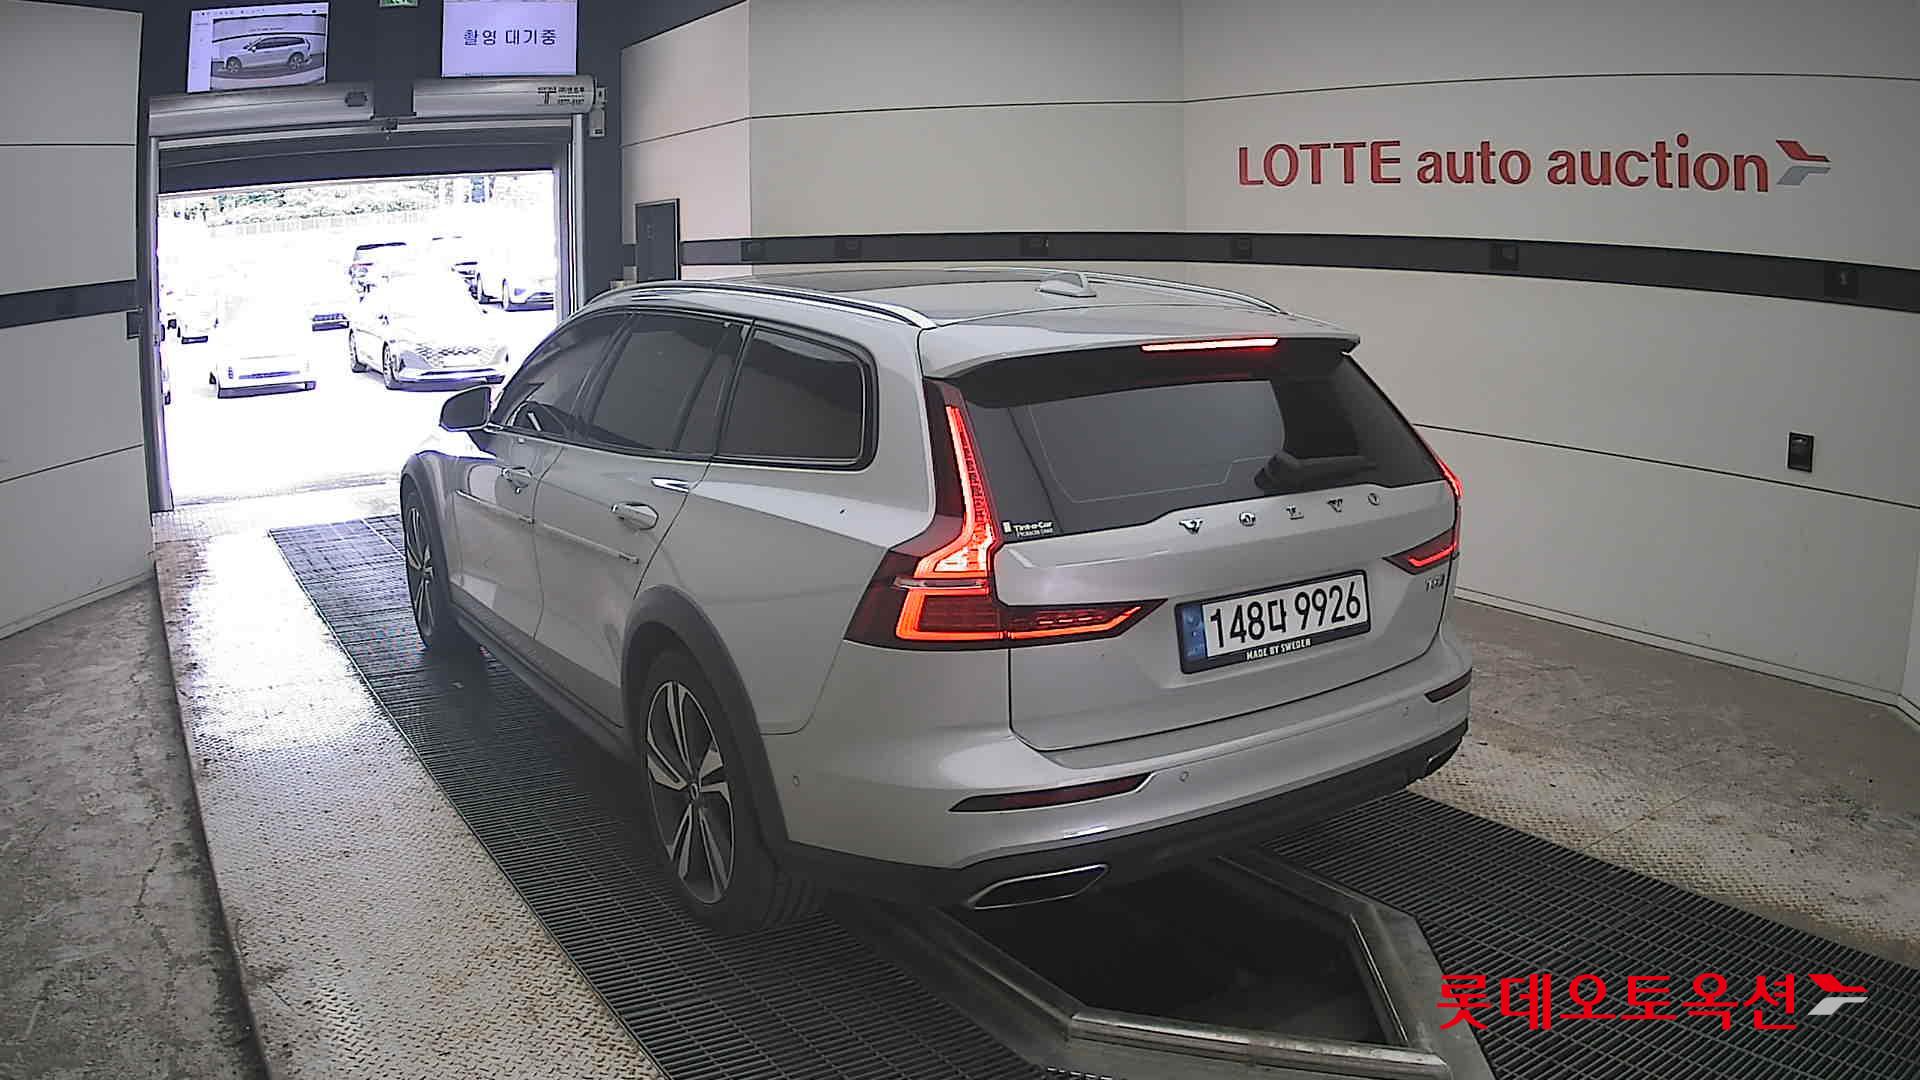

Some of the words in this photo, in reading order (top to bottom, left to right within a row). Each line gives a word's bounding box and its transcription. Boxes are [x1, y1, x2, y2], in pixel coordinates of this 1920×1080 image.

[464, 29, 496, 46] 촬영
[505, 29, 557, 46] 대기중
[1238, 140, 1401, 187] LOTTE
[1416, 140, 1531, 185] auto
[1547, 133, 1768, 193] auction
[1294, 581, 1361, 630] 9926
[1246, 647, 1268, 661] MADE
